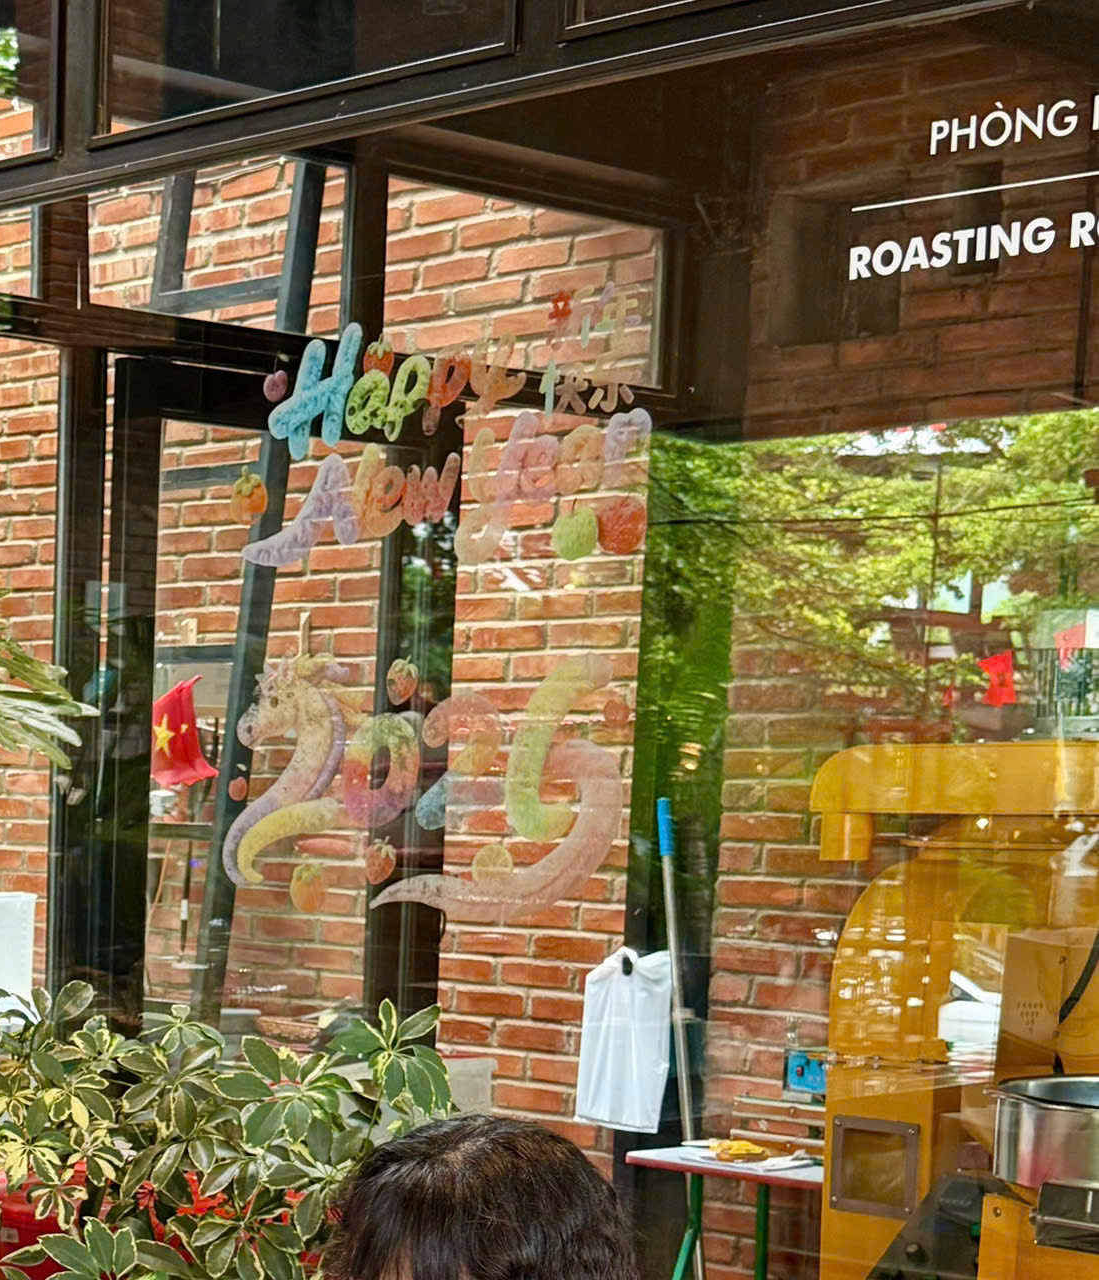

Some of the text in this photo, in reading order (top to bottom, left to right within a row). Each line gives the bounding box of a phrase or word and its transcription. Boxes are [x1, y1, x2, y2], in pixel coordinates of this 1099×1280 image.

[929, 99, 1079, 156] PHÒNG
[848, 211, 1099, 281] ROASTING R
[267, 321, 527, 461] Happy
